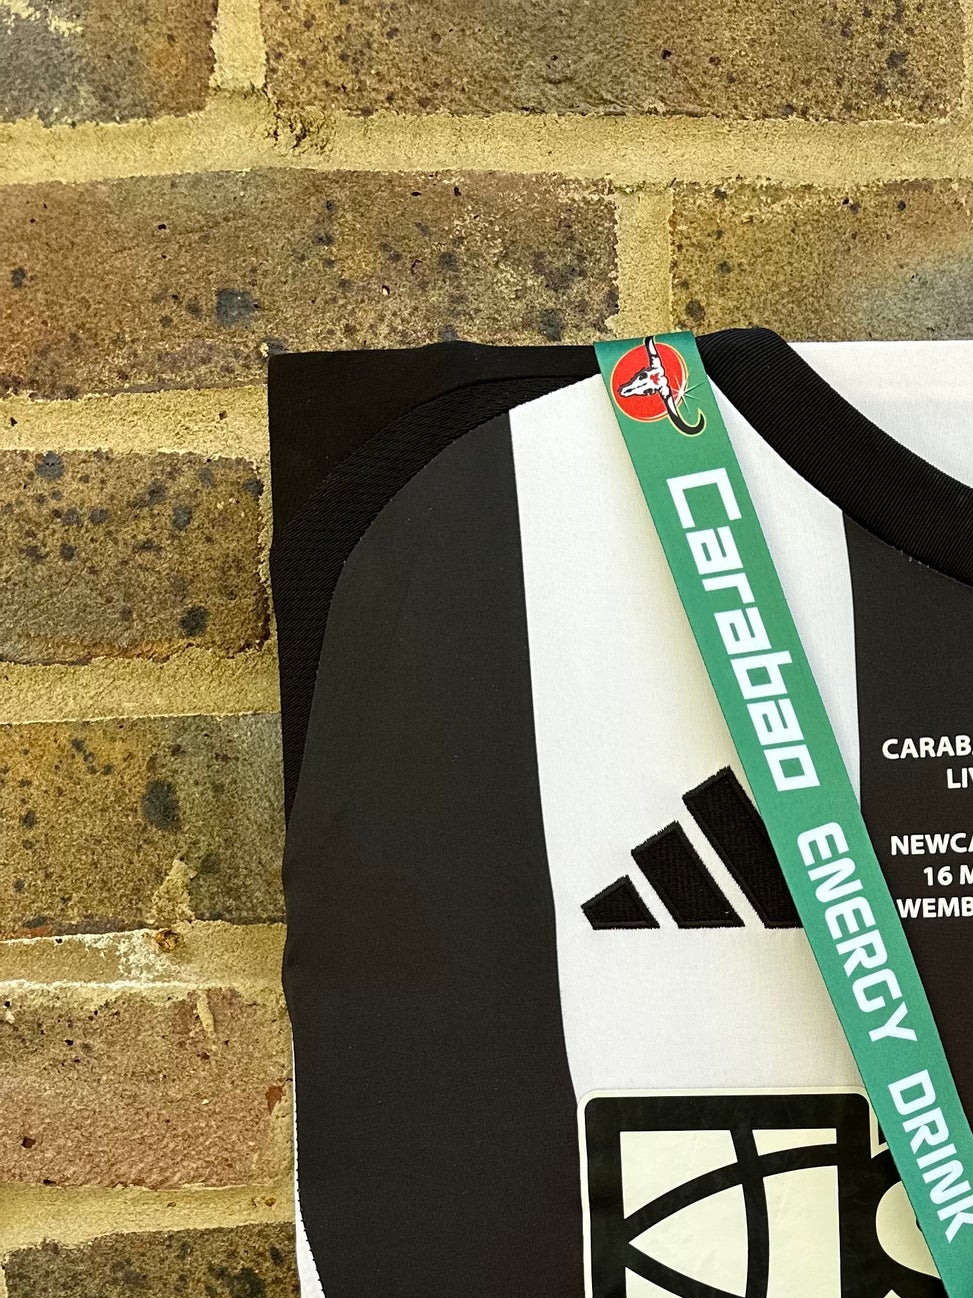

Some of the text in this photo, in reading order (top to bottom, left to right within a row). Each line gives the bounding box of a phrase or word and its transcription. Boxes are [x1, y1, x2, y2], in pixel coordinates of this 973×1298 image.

[667, 467, 820, 793] Carabao
[797, 821, 918, 1042] ENERGY
[923, 865, 953, 886] 16
